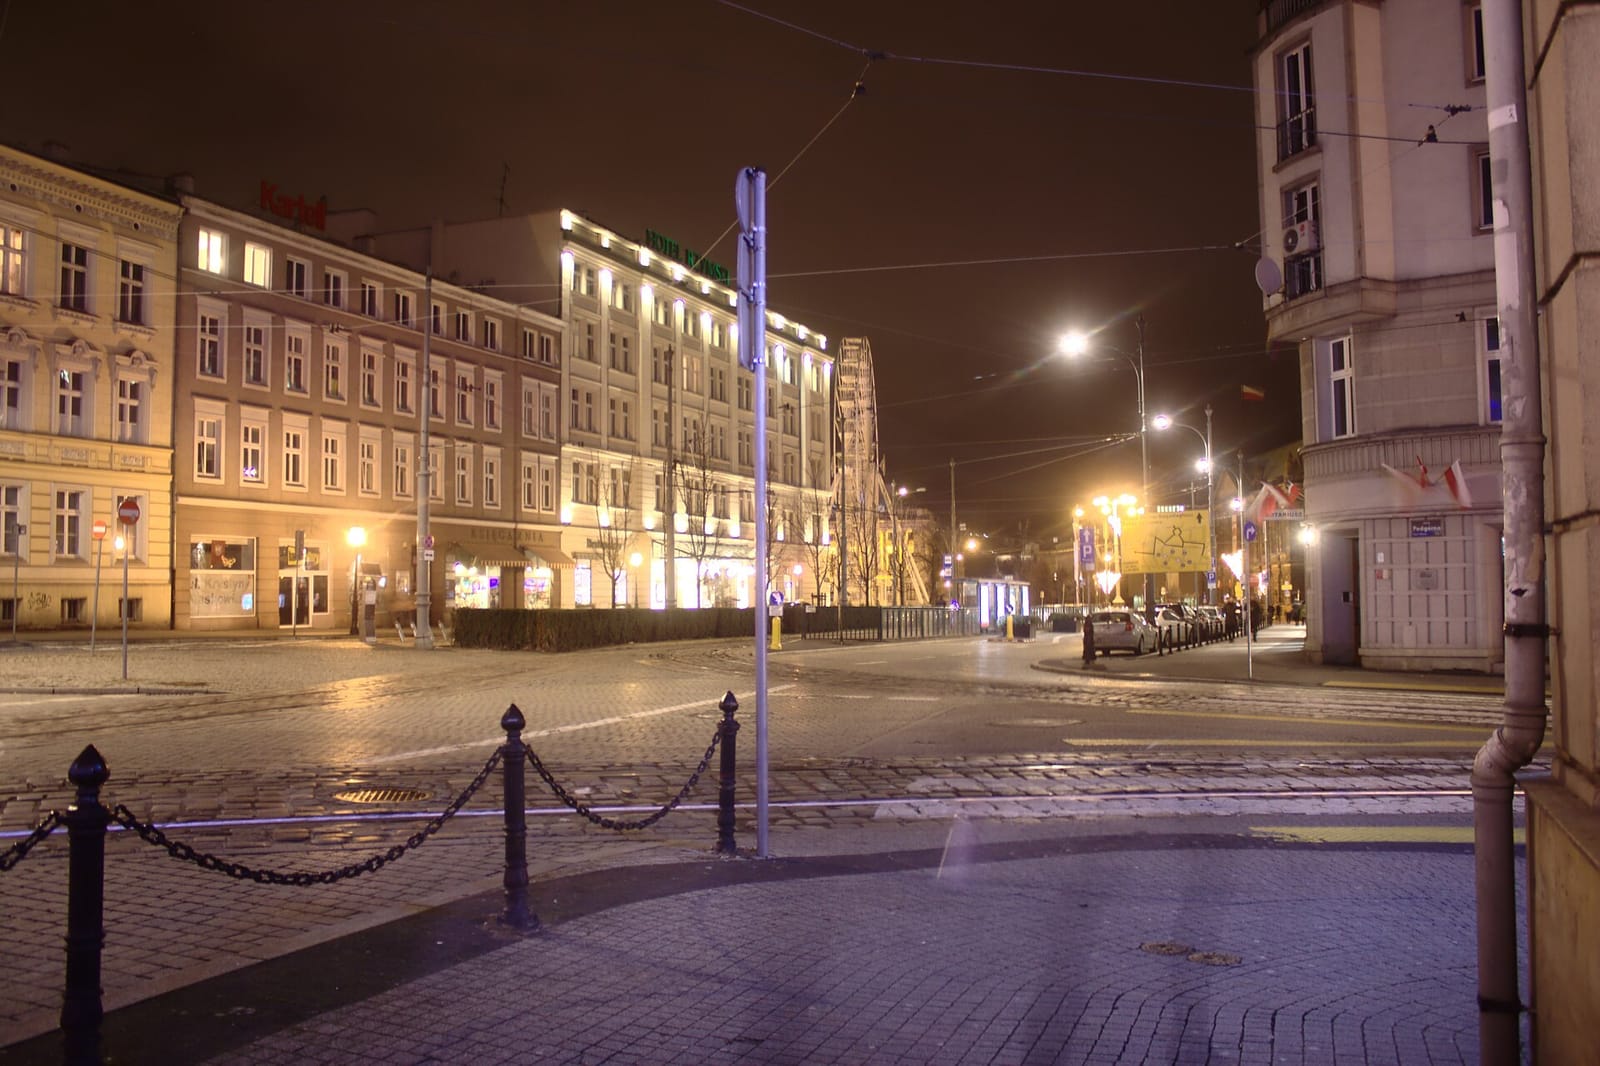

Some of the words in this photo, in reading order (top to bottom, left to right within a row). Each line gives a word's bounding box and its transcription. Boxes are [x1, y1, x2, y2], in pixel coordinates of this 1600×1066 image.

[645, 228, 681, 262] HOTEL
[1083, 545, 1093, 558] P
[1209, 573, 1215, 581] P
